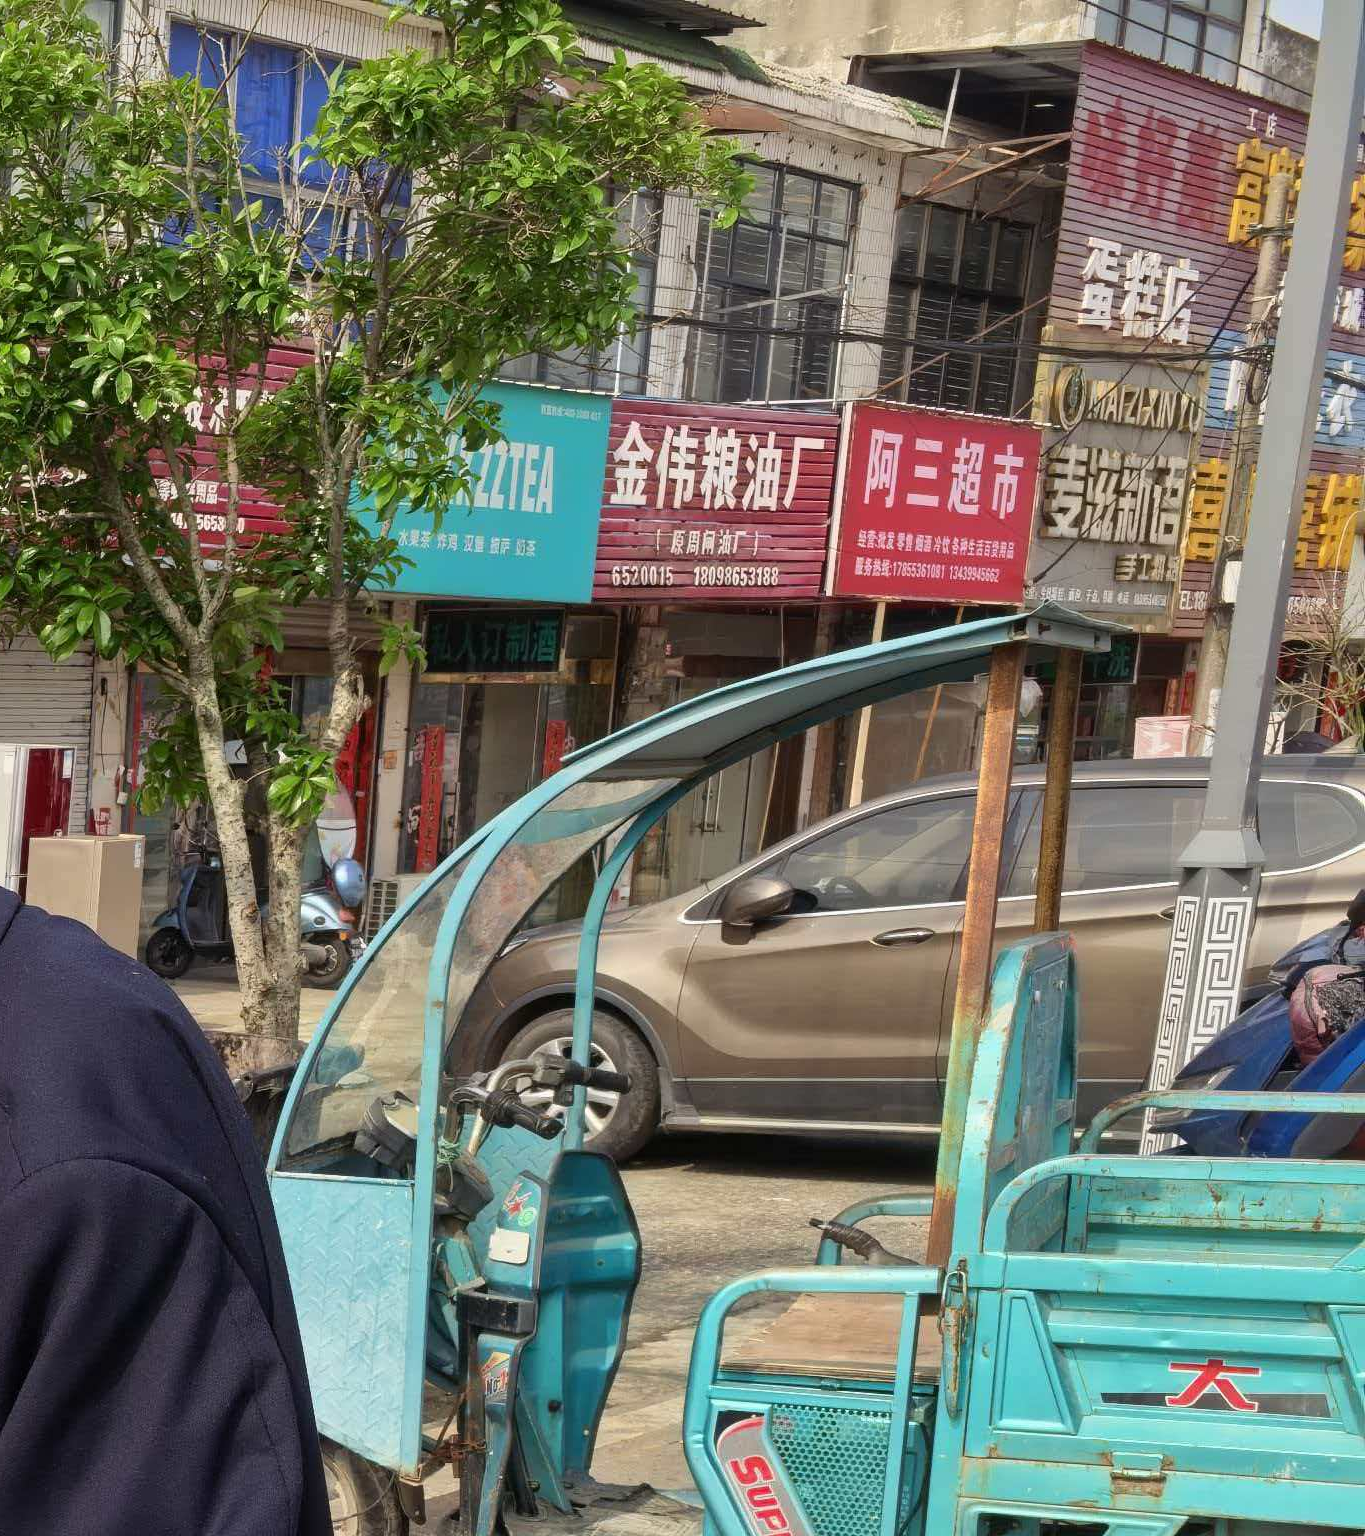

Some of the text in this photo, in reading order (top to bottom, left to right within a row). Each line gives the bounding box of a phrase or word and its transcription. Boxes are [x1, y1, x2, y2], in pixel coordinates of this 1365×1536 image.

[1076, 235, 1200, 347] 蛋糕店
[609, 420, 826, 512] 金伟粮油厂
[863, 428, 1025, 520] 阿三超市
[1039, 443, 1191, 546] 麦滋新语
[611, 565, 780, 587] 6520015 18098653188
